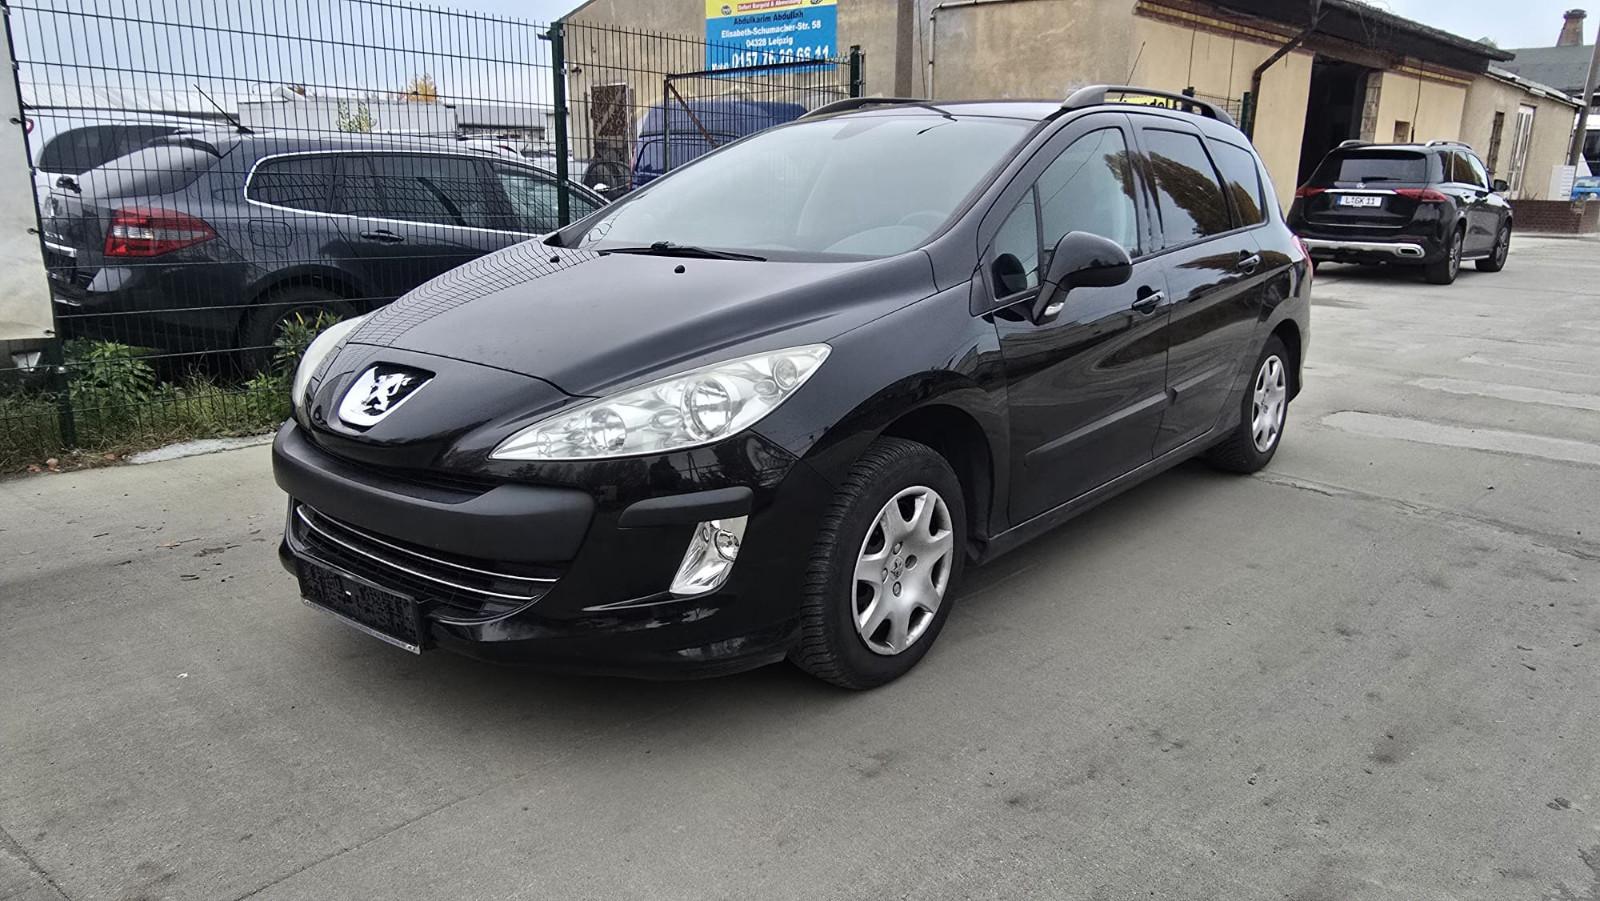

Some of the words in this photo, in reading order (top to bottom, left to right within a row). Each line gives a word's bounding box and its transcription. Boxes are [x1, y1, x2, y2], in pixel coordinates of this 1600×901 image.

[734, 14, 772, 25] Abdulkarim
[773, 10, 804, 21] Abdullah
[721, 22, 810, 38] Elisabeth-Schumacher-Str.
[812, 20, 822, 29] 58
[746, 38, 767, 48] 04328
[768, 36, 794, 46] Leipzig
